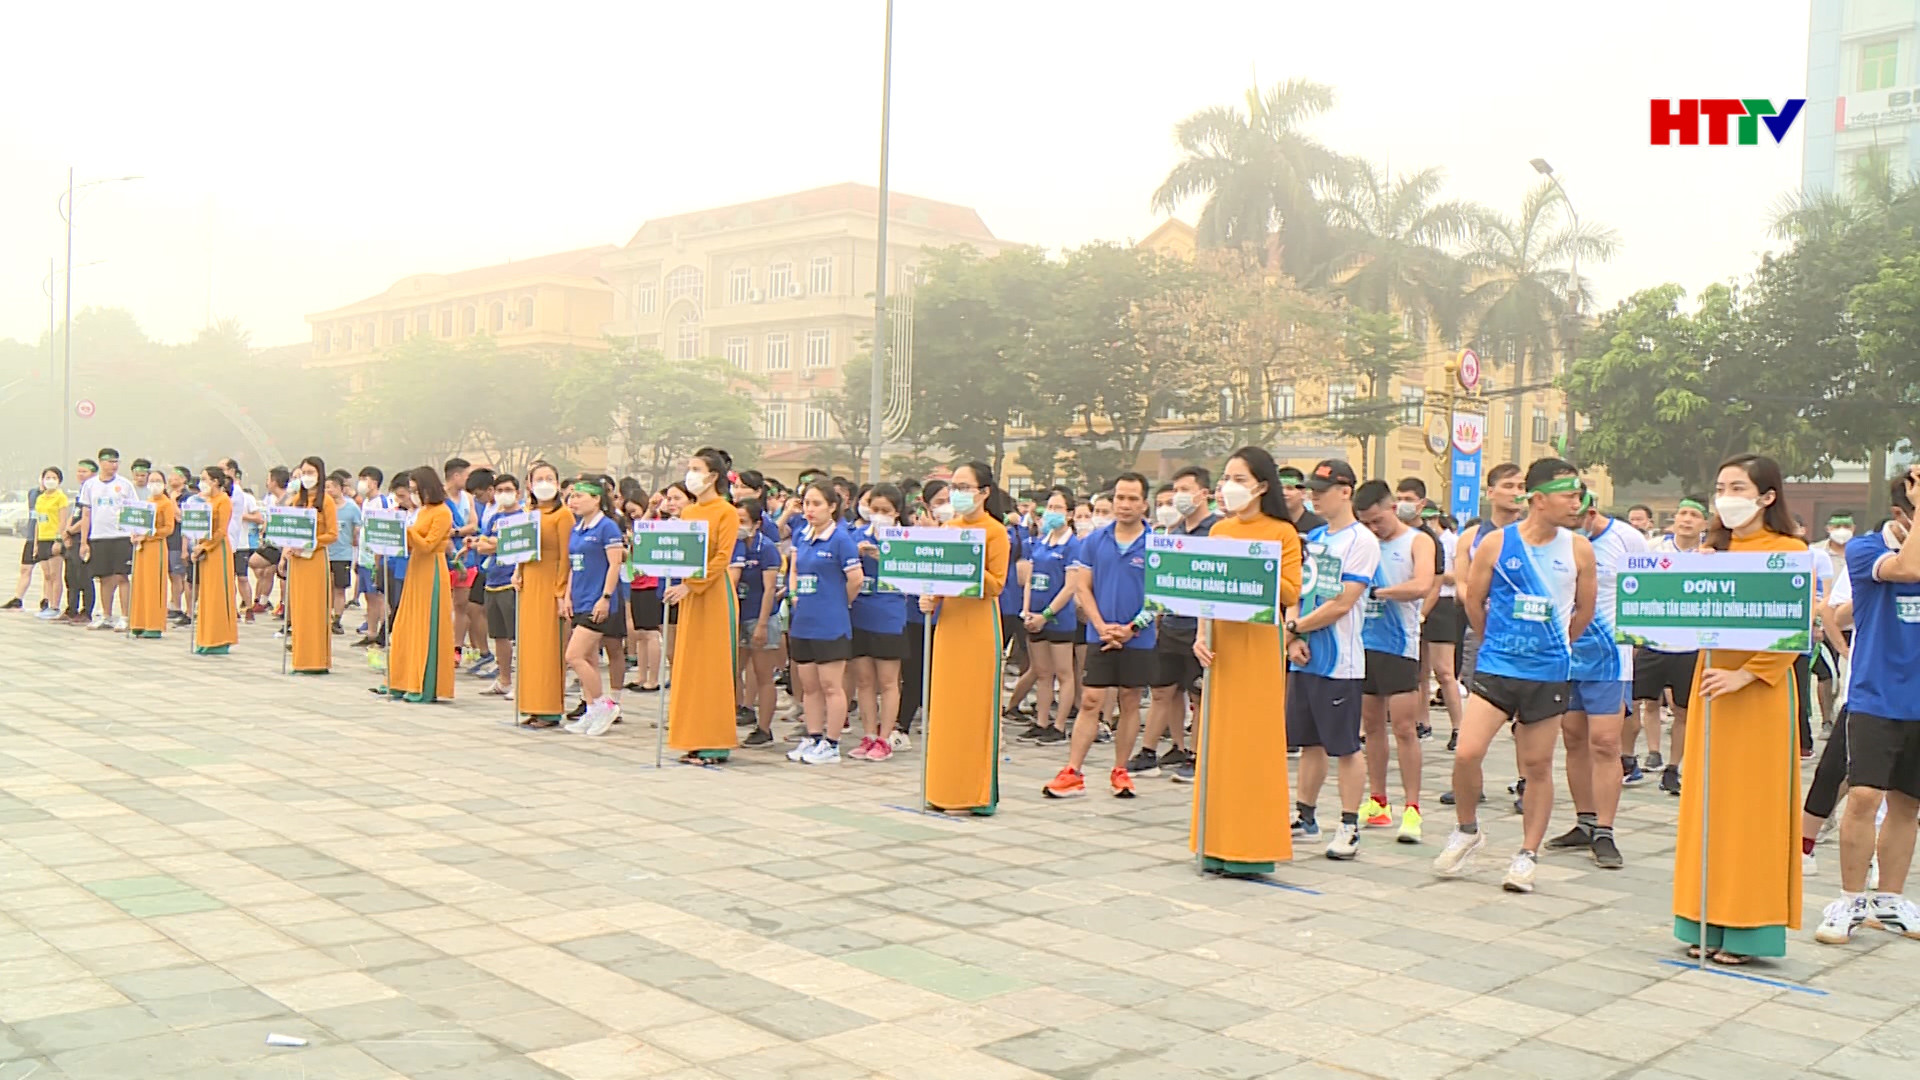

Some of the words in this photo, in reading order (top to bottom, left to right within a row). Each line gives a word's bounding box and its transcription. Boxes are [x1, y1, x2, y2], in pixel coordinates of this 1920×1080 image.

[1191, 560, 1215, 572] ĐƠN
[1216, 561, 1228, 576] VỊ
[1628, 557, 1659, 569] BIDV
[1683, 578, 1717, 593] ĐƠN
[1720, 580, 1736, 597] VỊ
